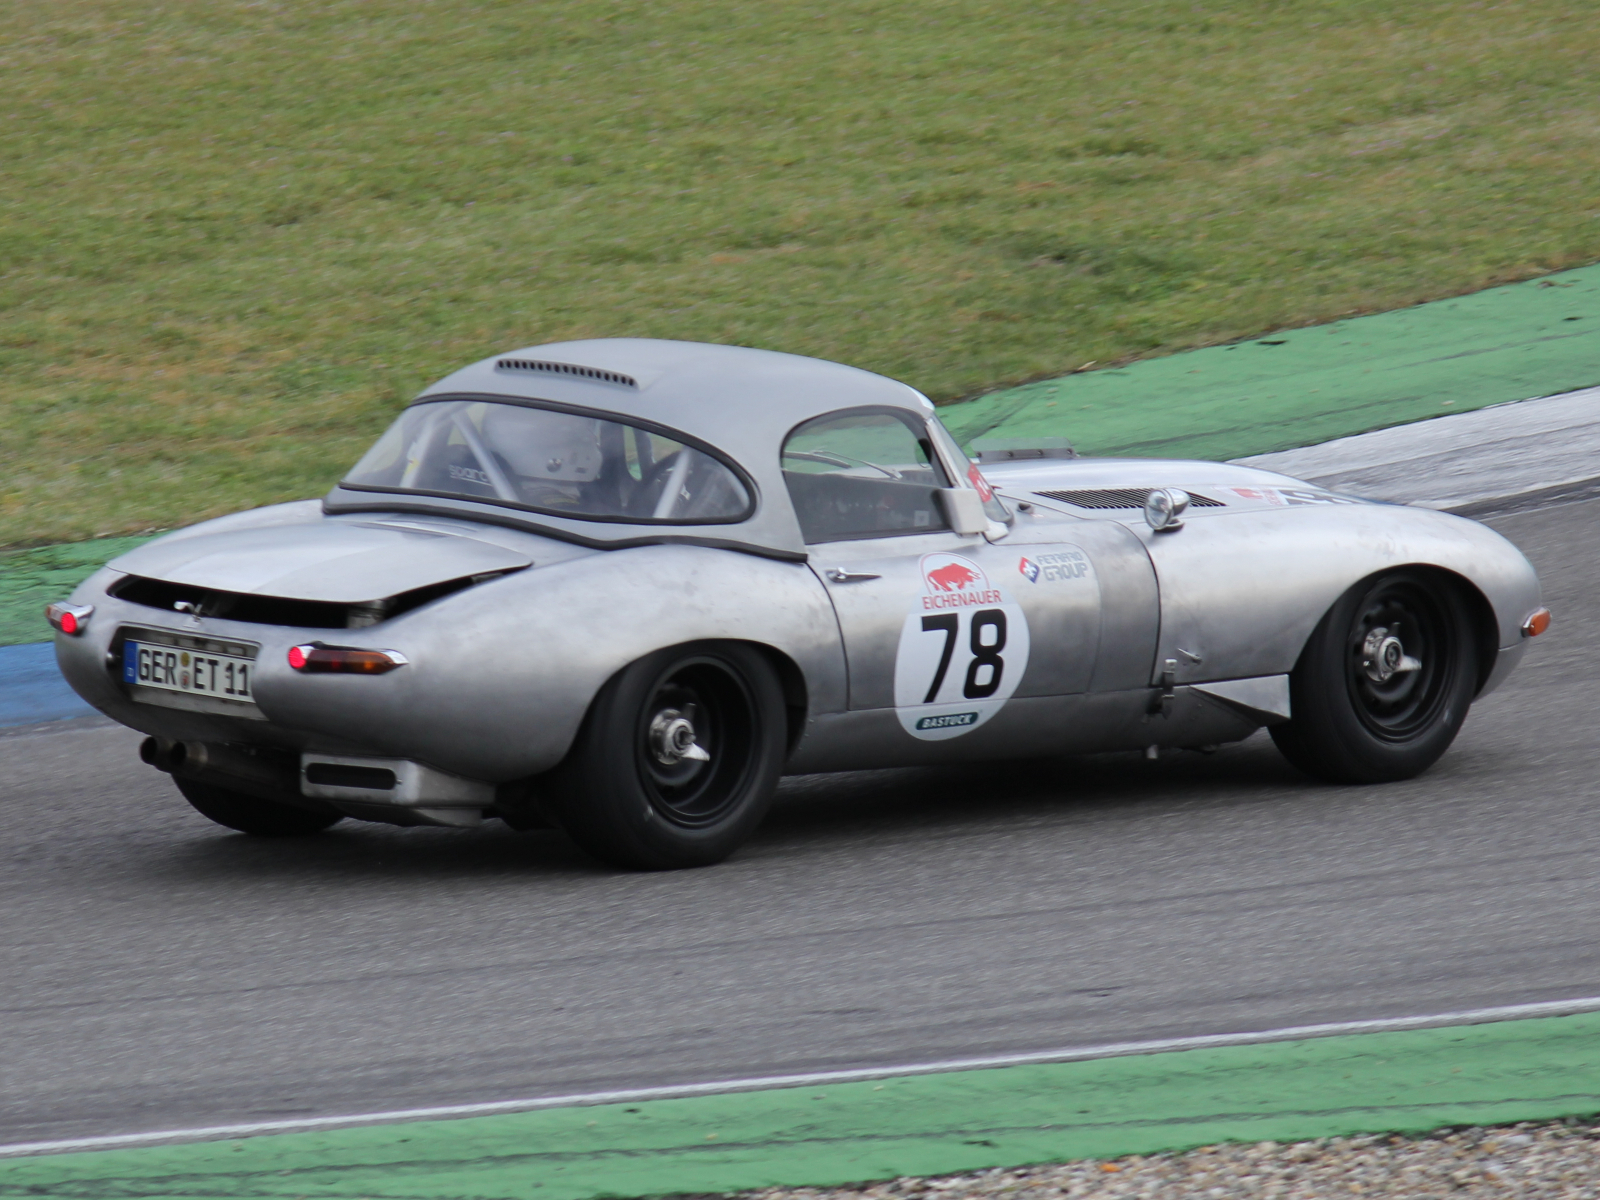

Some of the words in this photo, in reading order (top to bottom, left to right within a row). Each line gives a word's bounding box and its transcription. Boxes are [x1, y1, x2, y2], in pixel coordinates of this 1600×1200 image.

[449, 464, 490, 482] sparc
[1043, 562, 1088, 581] GROUP
[922, 589, 1002, 610] EICHENAUER
[921, 608, 1007, 703] 78
[138, 649, 177, 685] GER
[193, 656, 219, 691] ET
[921, 713, 973, 728] BASTUCK
